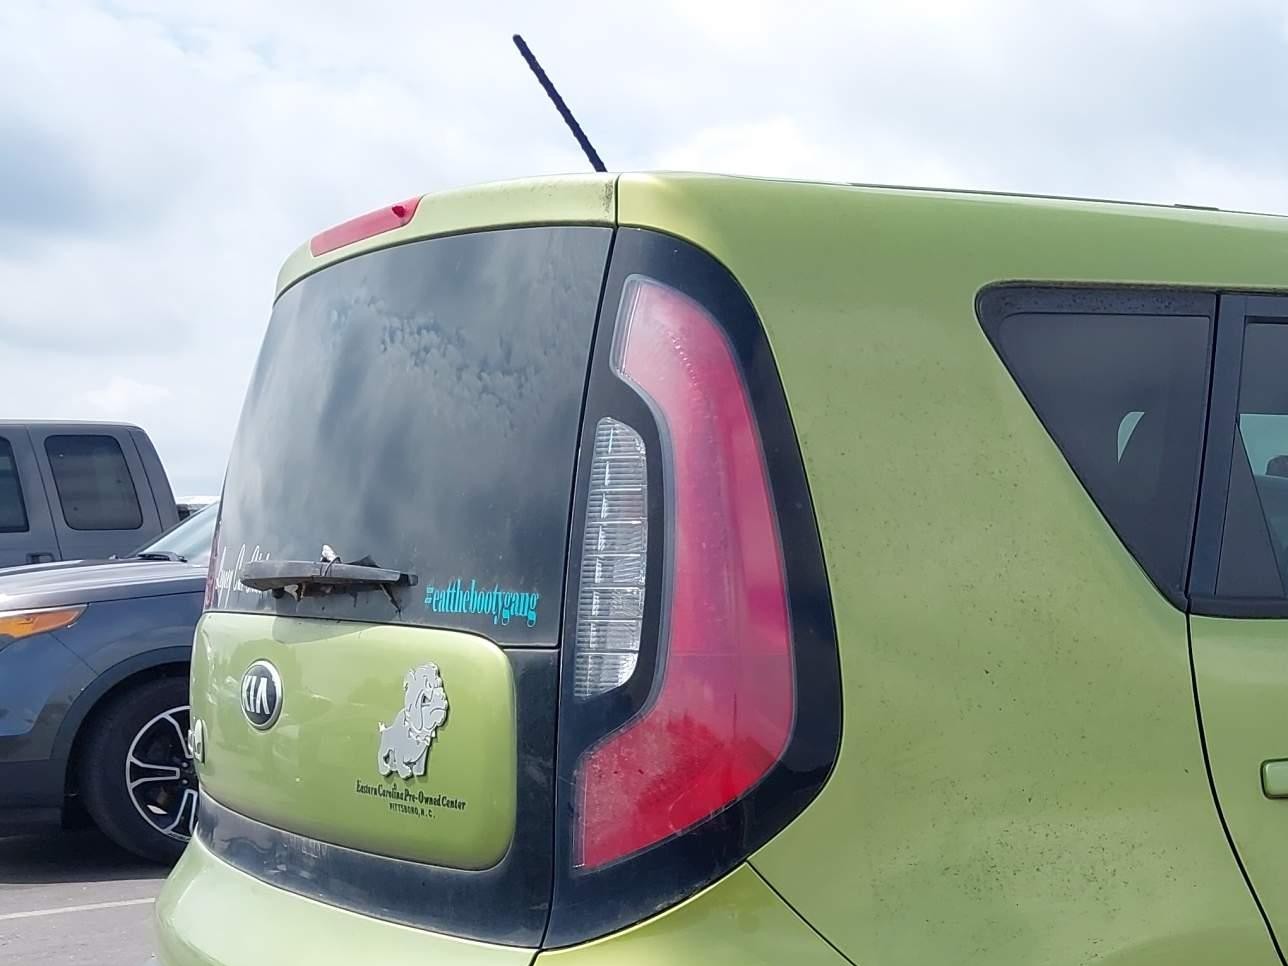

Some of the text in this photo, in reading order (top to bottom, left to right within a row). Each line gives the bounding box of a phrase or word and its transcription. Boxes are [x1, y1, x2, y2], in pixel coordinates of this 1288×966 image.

[243, 674, 271, 715] KIA
[356, 780, 466, 810] Eastern Carolina Pre-Owned Center
